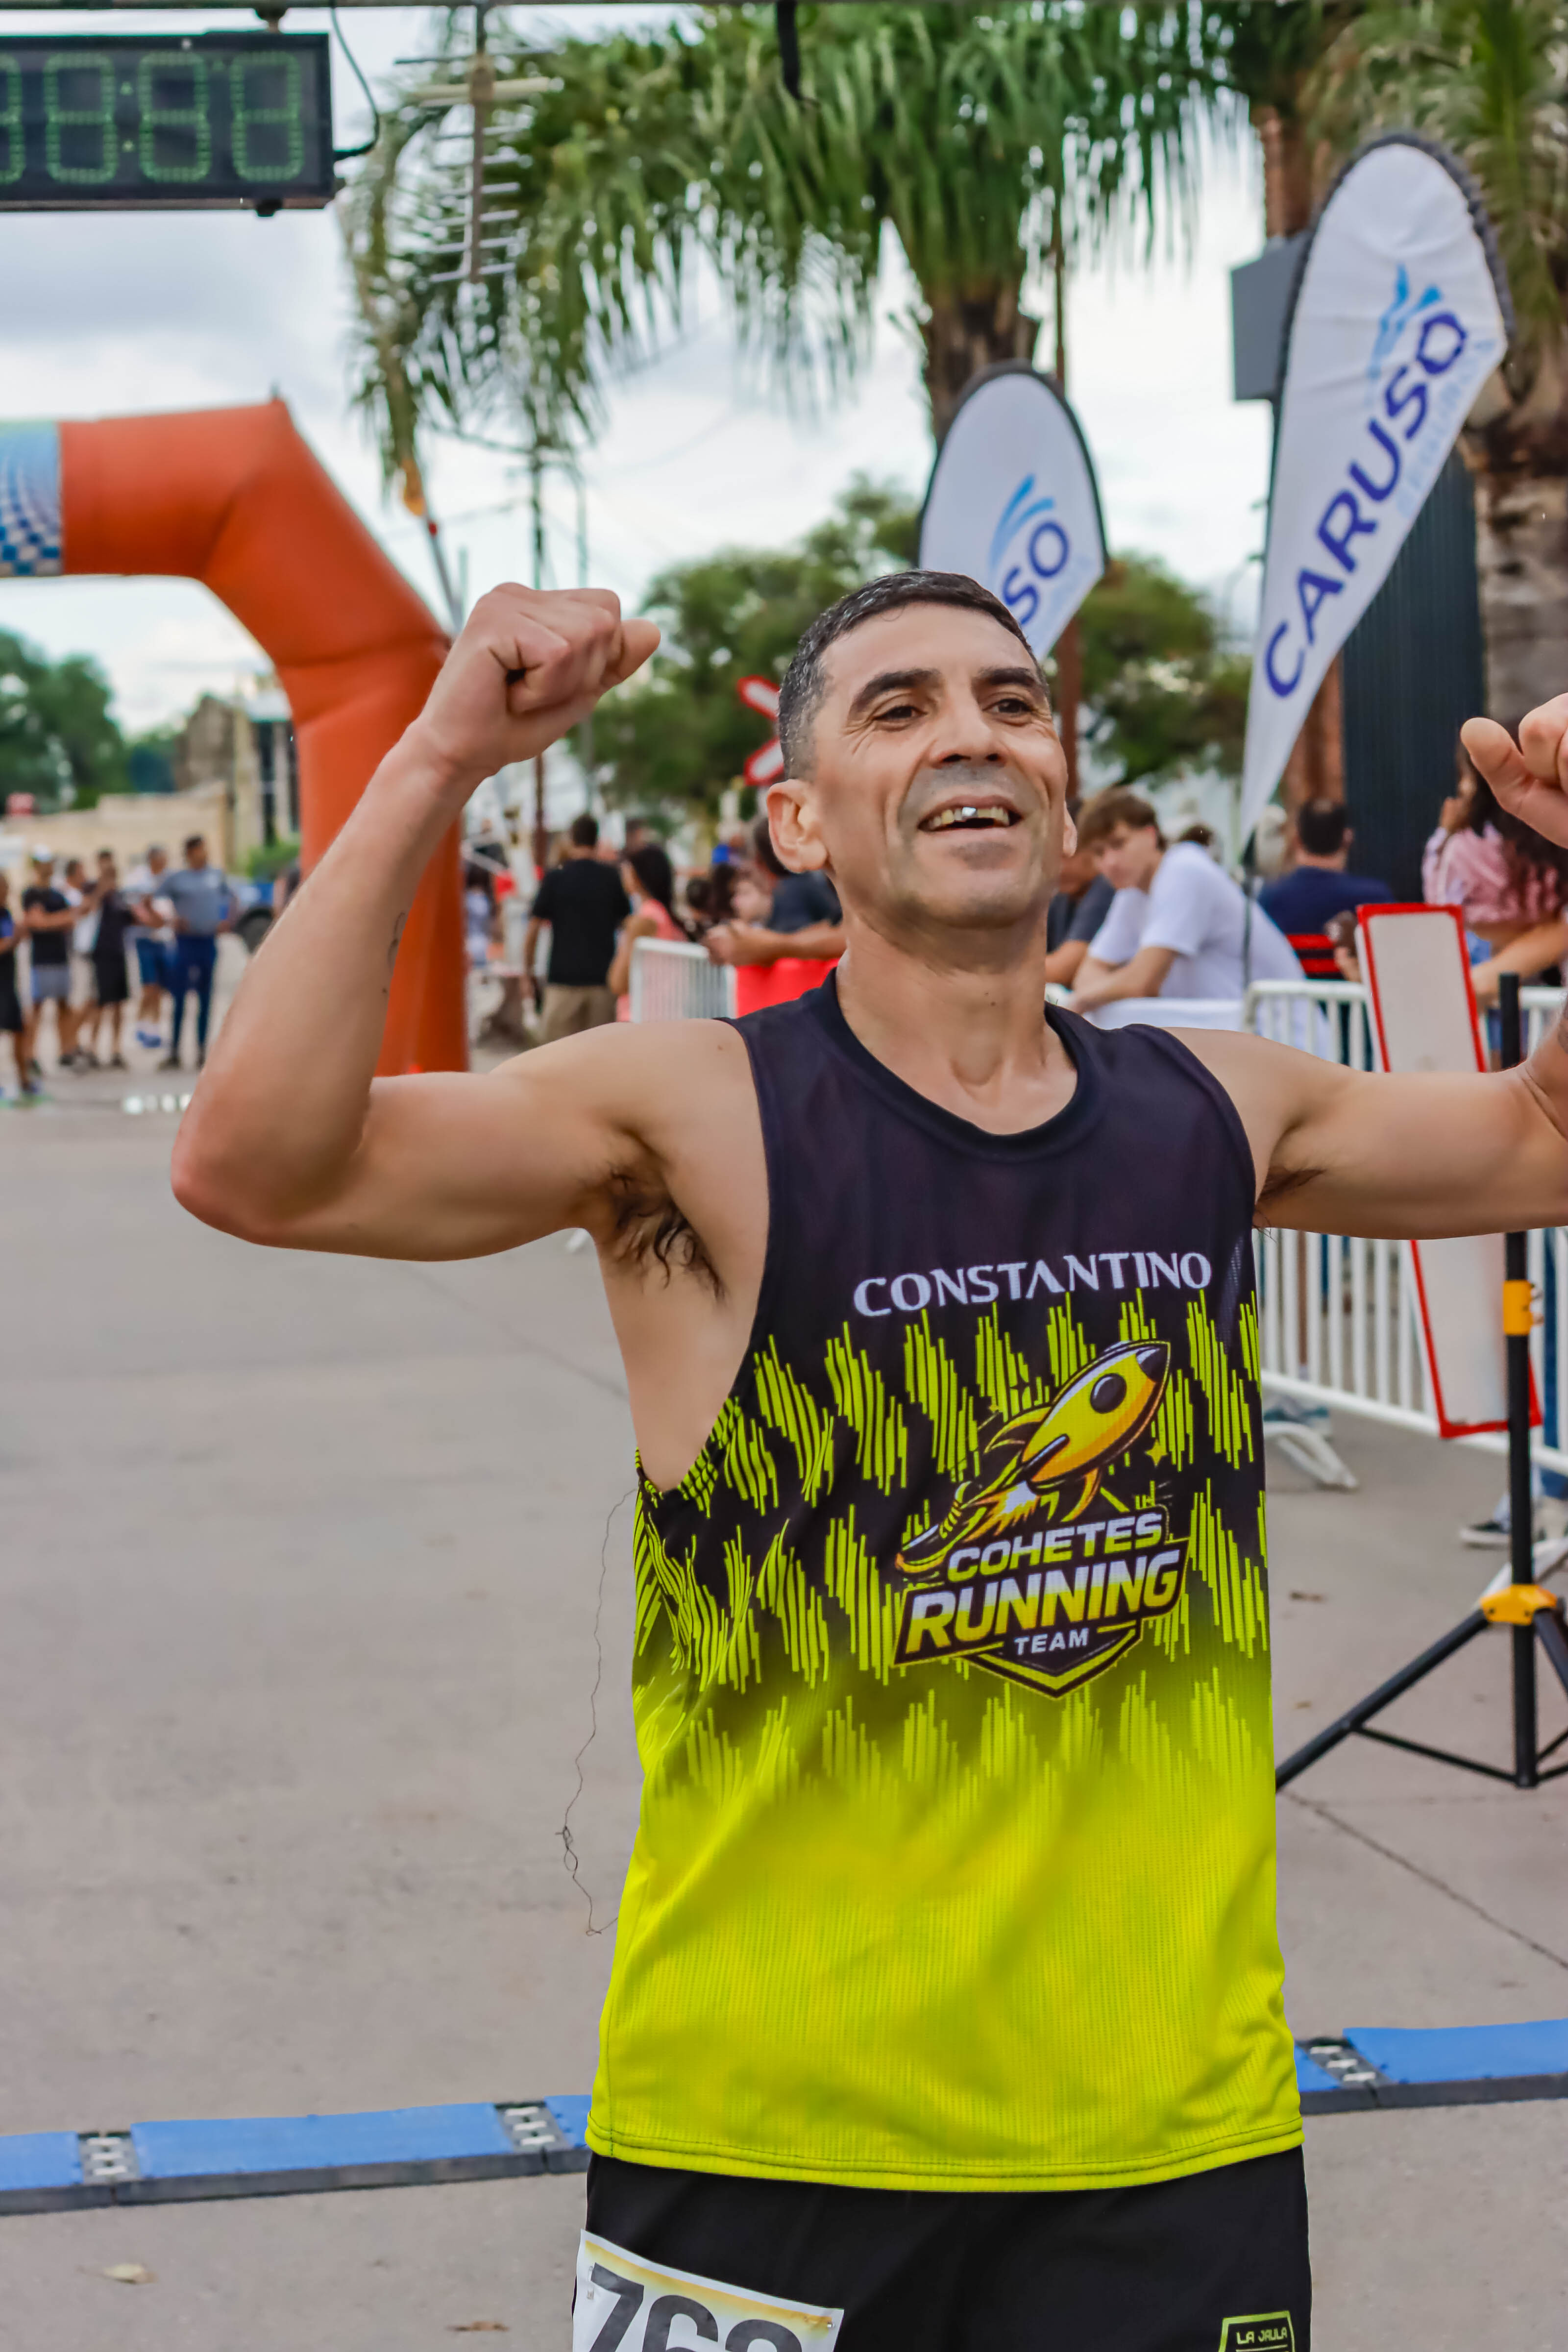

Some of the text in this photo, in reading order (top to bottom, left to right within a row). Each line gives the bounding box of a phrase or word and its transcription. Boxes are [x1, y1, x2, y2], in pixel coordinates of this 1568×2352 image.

[1263, 312, 1467, 698] CARUSO
[853, 1252, 1212, 1317] CONSTANTINO
[947, 1512, 1162, 1582] COHETES
[905, 1549, 1181, 1654] RUNNING
[1014, 1628, 1089, 1655] TEAM
[588, 2262, 803, 2352] 76
[1236, 2327, 1288, 2345] LA JAULA
